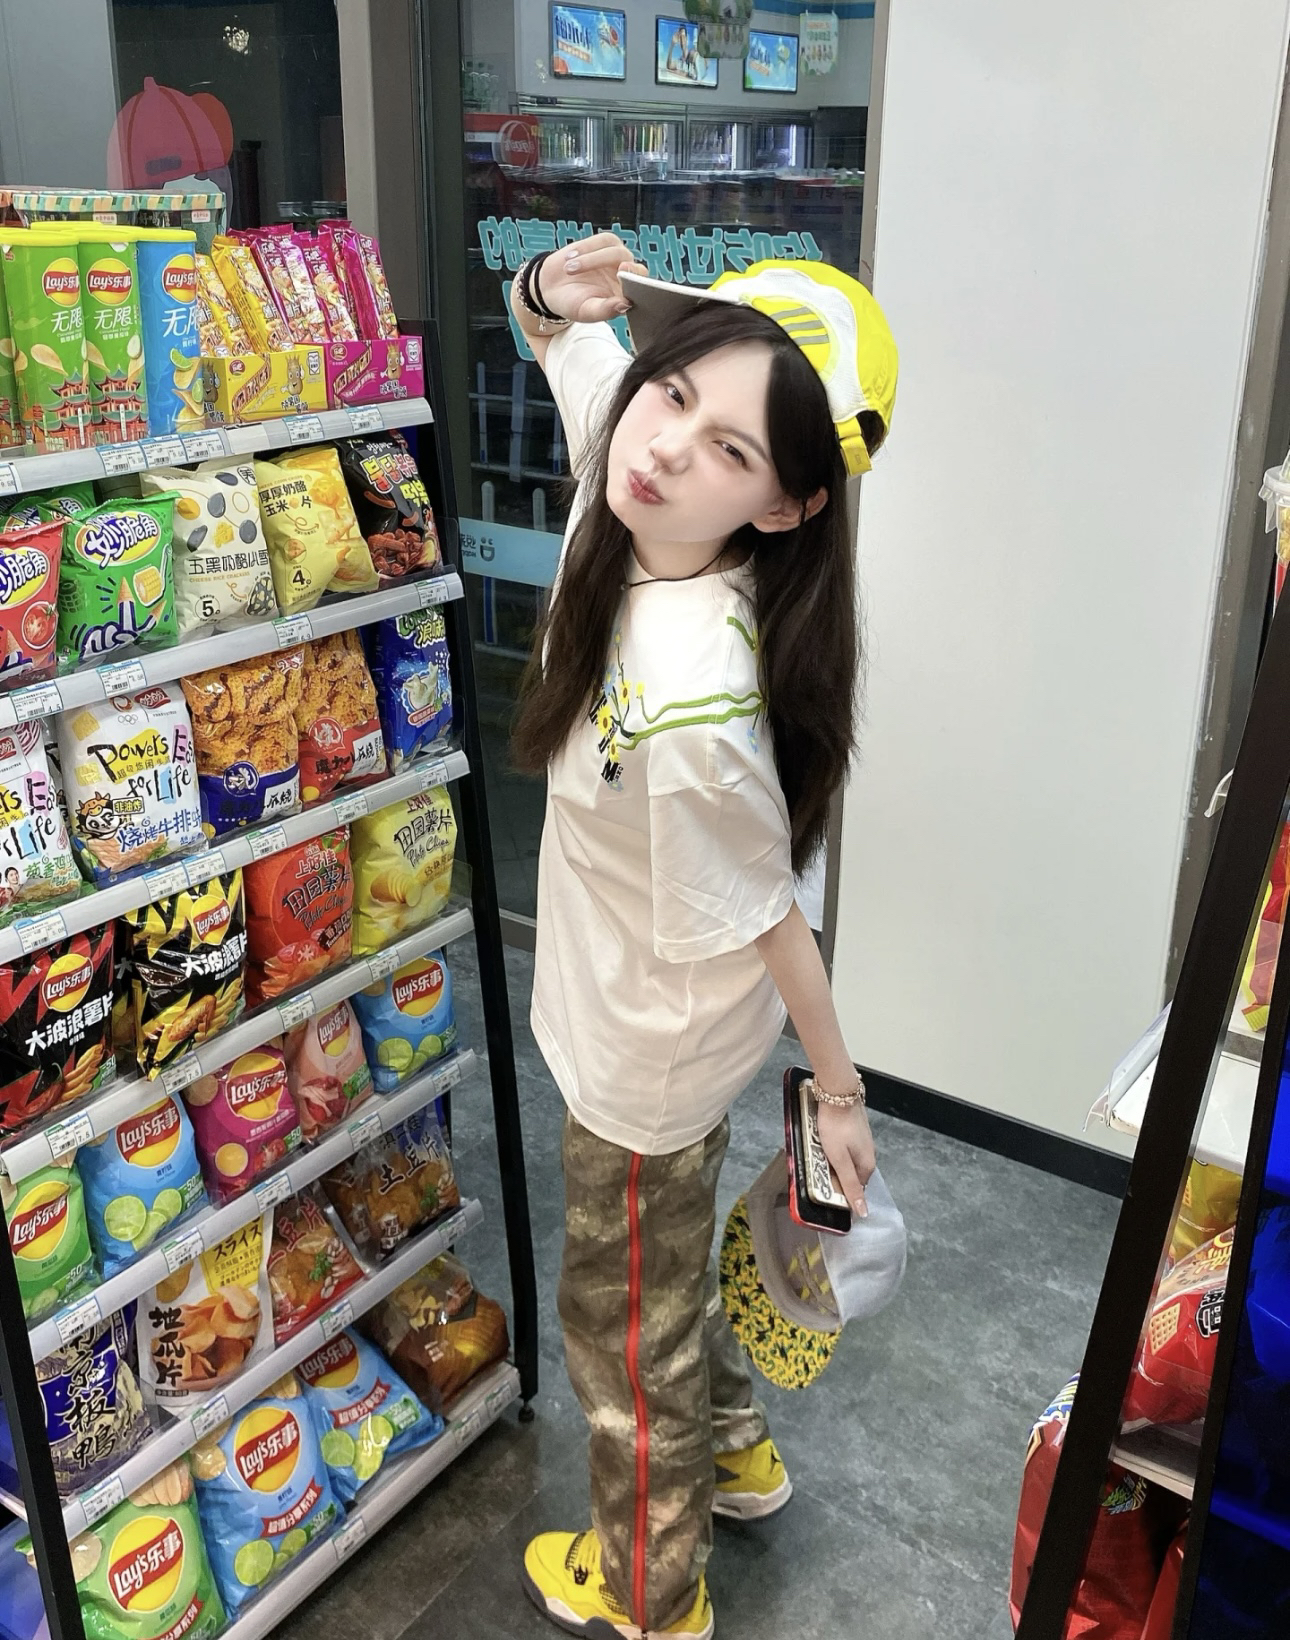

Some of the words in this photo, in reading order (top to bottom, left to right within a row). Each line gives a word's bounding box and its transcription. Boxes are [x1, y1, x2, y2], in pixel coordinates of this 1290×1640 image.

[93, 306, 133, 331] 无限
[259, 480, 307, 504] 厚厚奶酪
[86, 513, 158, 569] 妙脆角
[87, 734, 169, 783] Powers
[172, 729, 195, 763] Eas
[154, 765, 191, 802] Life
[114, 801, 143, 813] 非油炸
[393, 807, 453, 855] 田园薯片
[295, 848, 338, 879] 上好佳
[25, 991, 114, 1056] 大波浪薯片
[379, 1131, 441, 1196] 土豆片
[212, 1223, 263, 1263] スライス
[149, 1306, 186, 1387] 地瓜片
